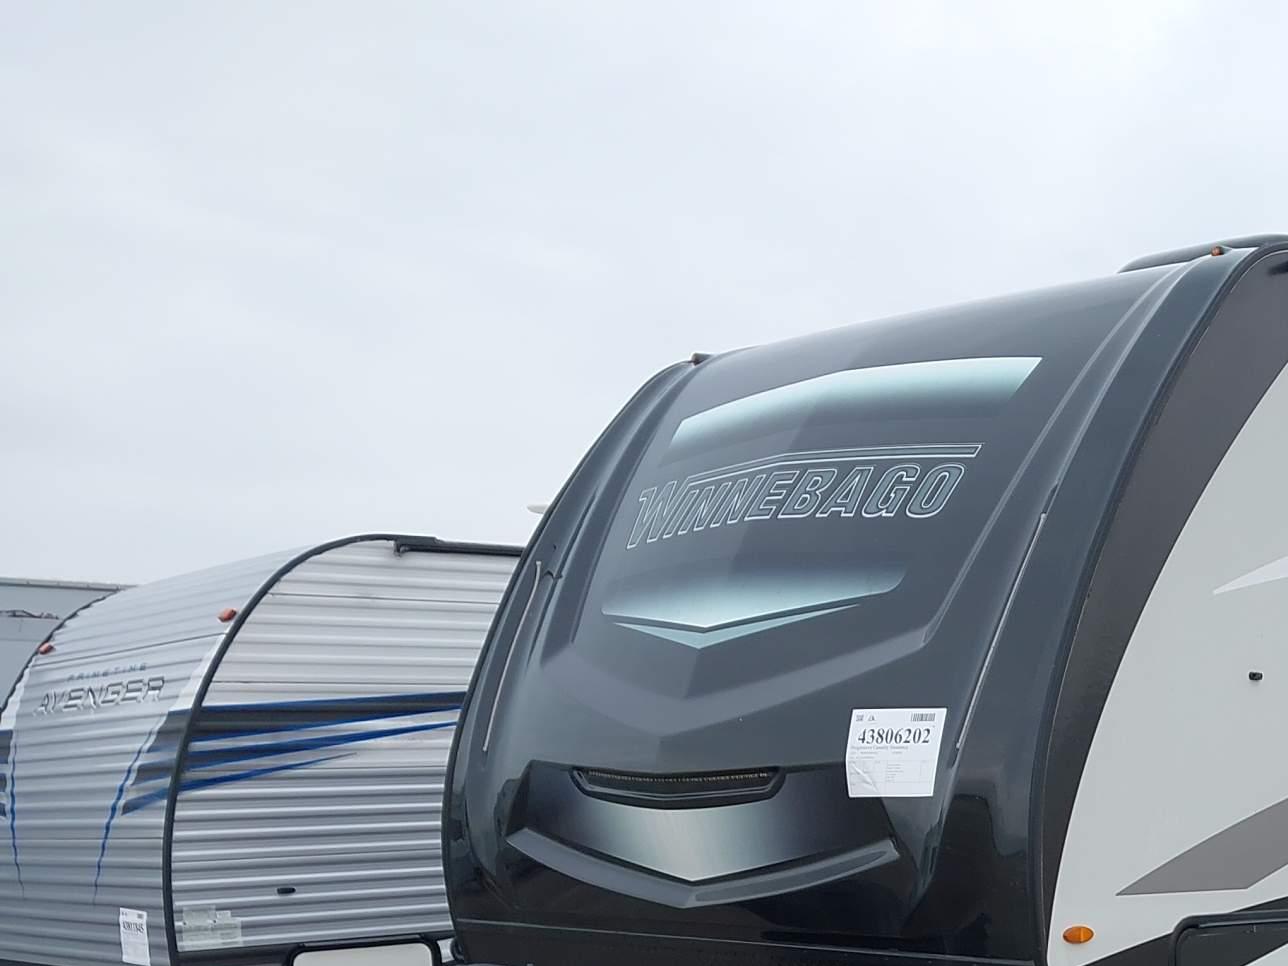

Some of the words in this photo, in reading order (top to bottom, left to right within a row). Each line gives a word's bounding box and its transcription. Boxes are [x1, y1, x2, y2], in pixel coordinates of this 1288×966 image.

[626, 463, 967, 549] WINNEBAGO
[33, 676, 165, 715] AVENGER
[857, 727, 931, 745] 43806202
